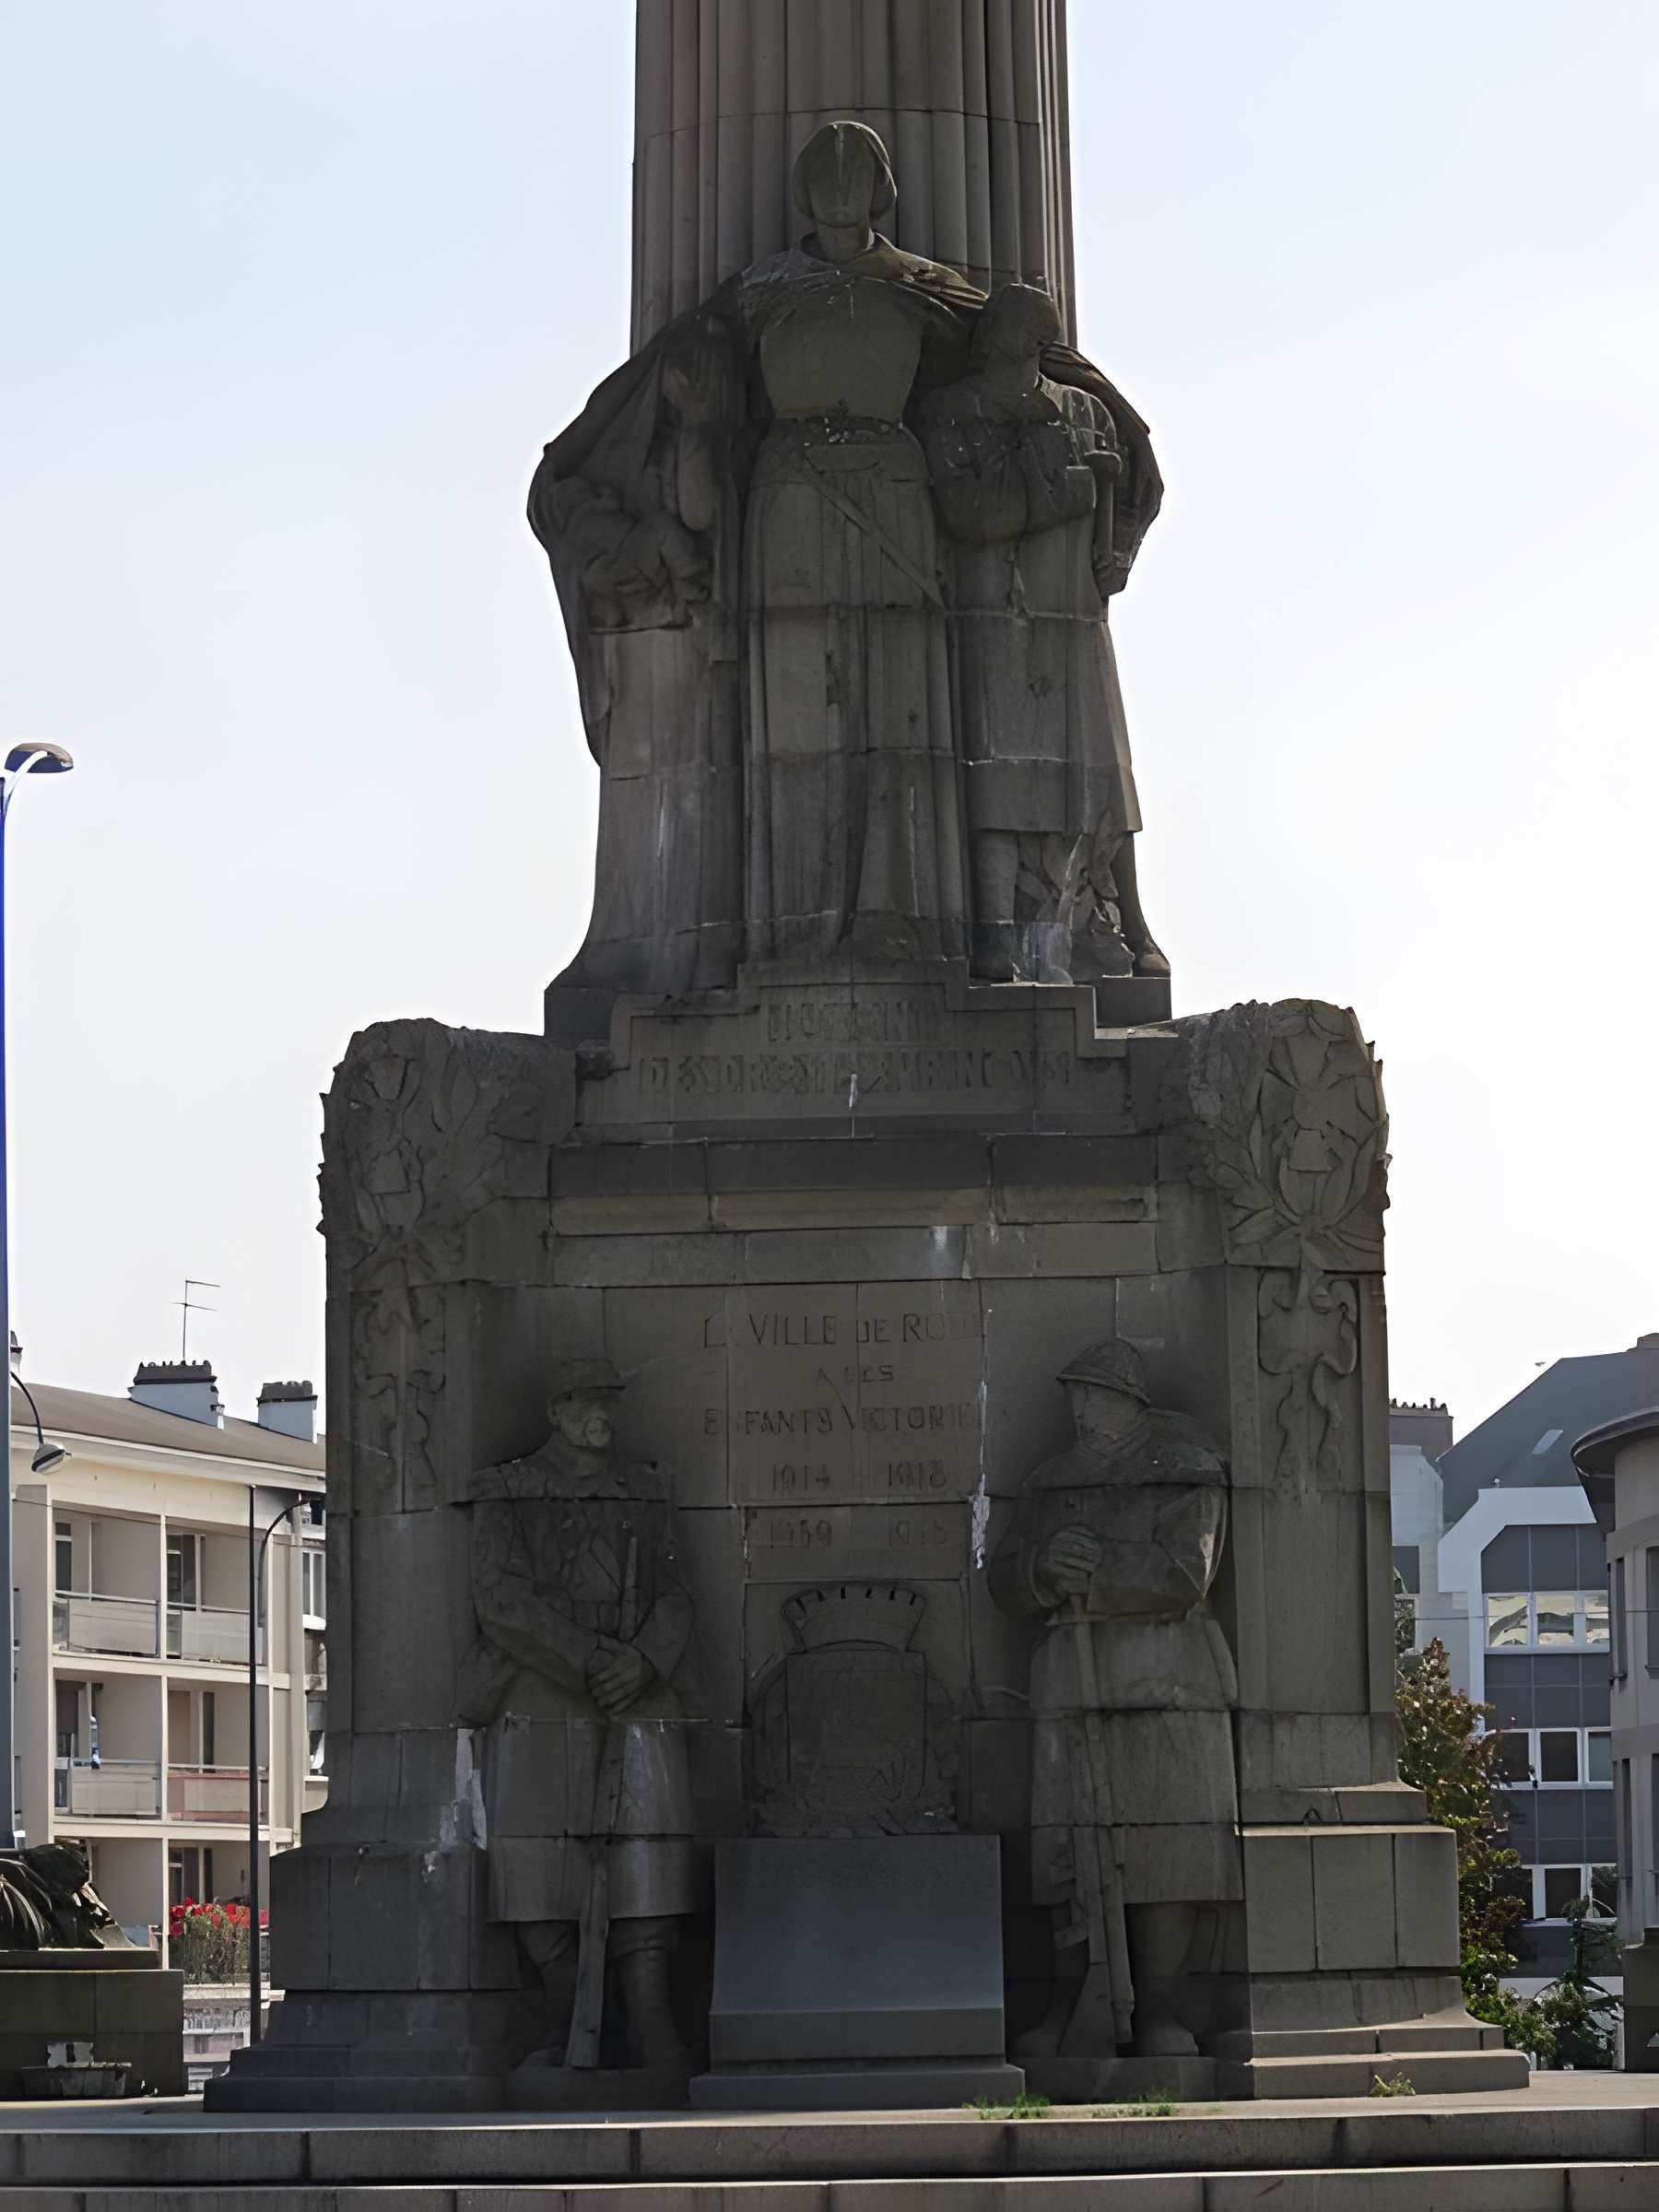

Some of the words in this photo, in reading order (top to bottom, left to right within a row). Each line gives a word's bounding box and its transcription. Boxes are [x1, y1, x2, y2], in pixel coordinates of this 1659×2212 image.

[748, 1312, 837, 1346] VILLE
[856, 1317, 890, 1343] DE
[703, 1407, 833, 1435] EFANTS
[772, 1463, 830, 1491] 1914
[888, 1460, 947, 1489] 1918
